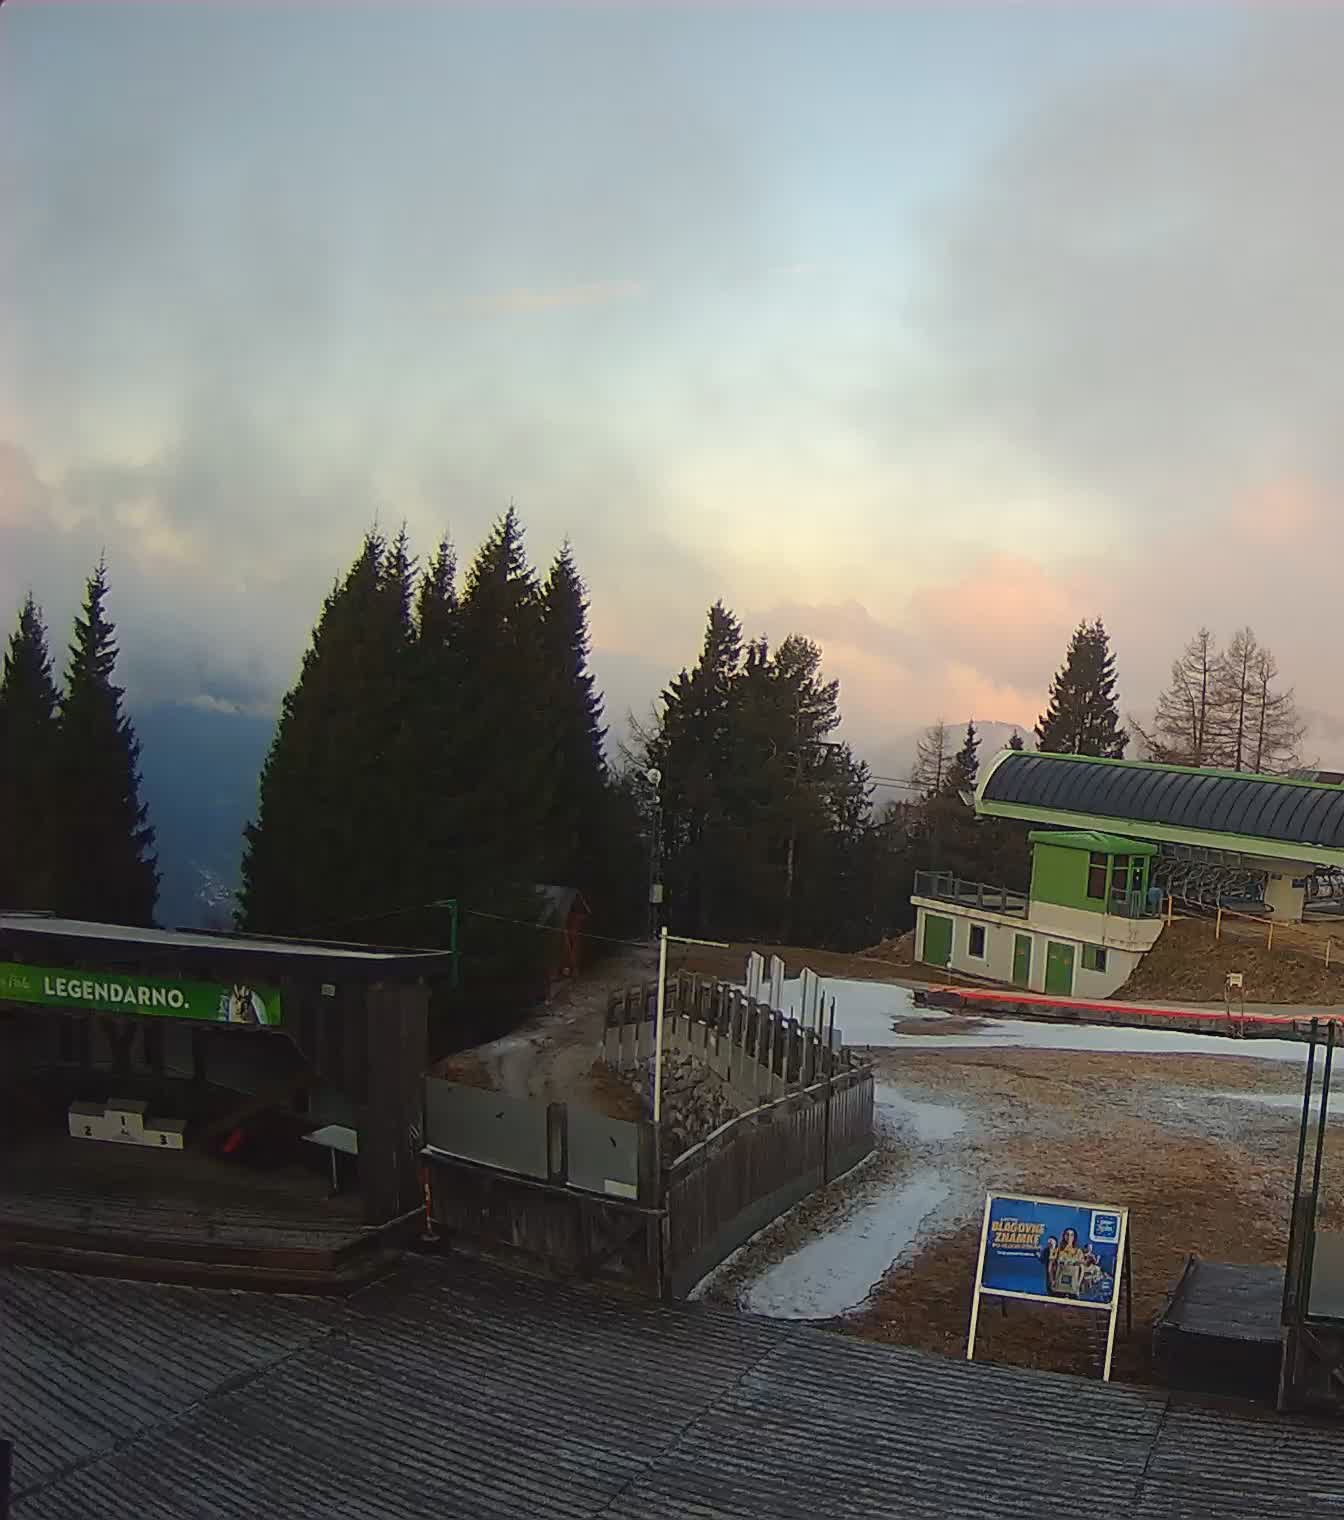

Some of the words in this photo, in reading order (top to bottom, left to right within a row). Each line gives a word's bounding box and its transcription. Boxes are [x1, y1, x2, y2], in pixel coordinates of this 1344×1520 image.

[43, 976, 190, 1009] LEGENDARNO.
[84, 1125, 92, 1137] 2
[159, 1134, 168, 1146] 3
